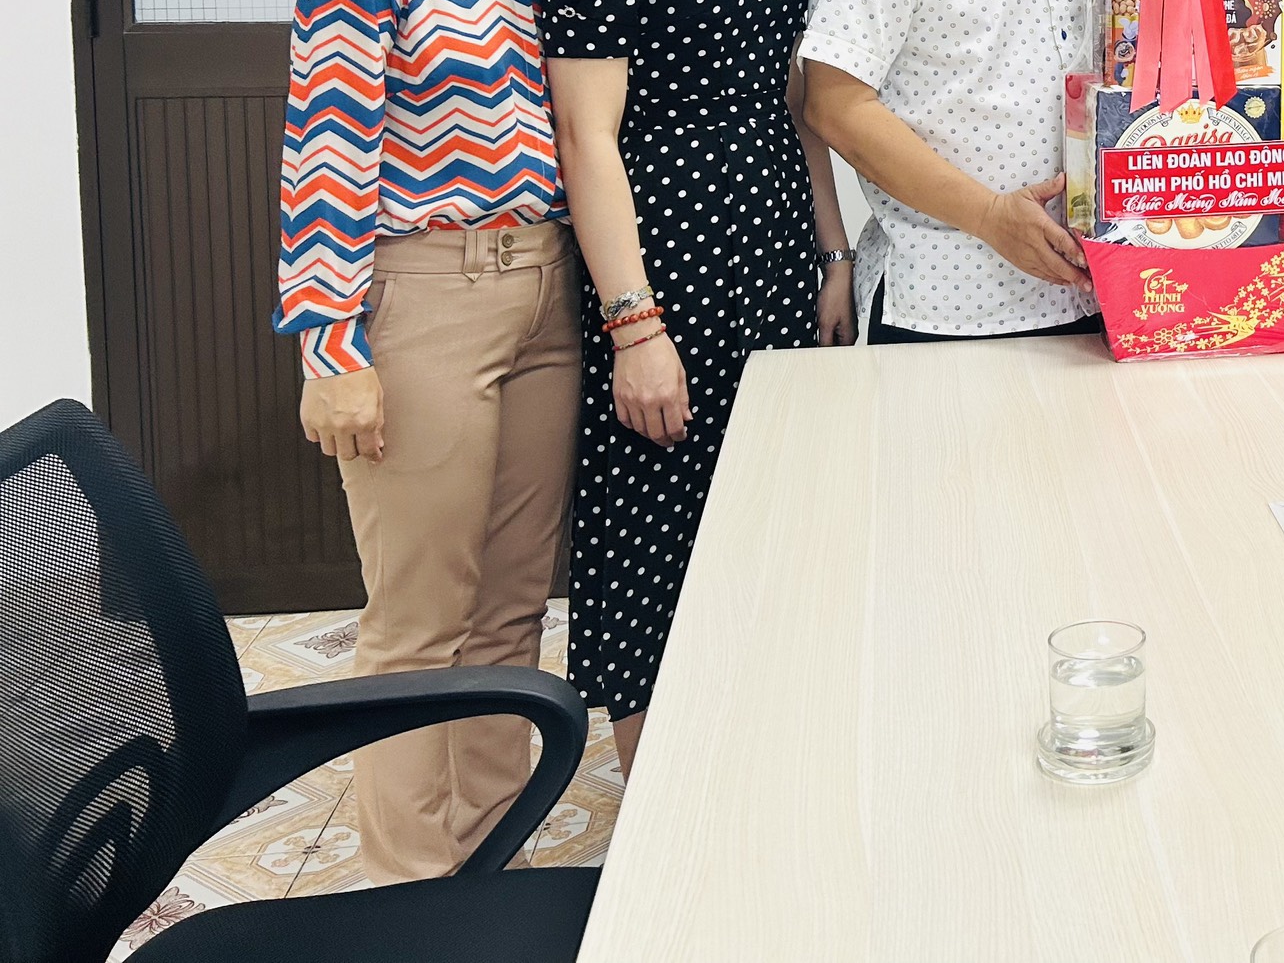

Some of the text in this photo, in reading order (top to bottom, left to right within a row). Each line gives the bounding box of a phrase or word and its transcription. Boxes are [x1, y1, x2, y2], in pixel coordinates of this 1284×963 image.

[1128, 151, 1163, 170] LIÊN
[1167, 149, 1211, 169] ĐOÀN
[1216, 150, 1245, 166] LAO
[1111, 174, 1166, 194] THÀNH
[1171, 170, 1205, 191] PHỐ
[1209, 168, 1231, 190] HỒ
[1236, 168, 1263, 188] CHÍ
[1122, 194, 1164, 214] Chúc
[1165, 192, 1216, 213] Mừng
[1218, 189, 1258, 209] Năm
[1143, 292, 1182, 305] THỊNH
[1141, 303, 1185, 316] VƯỢNG
